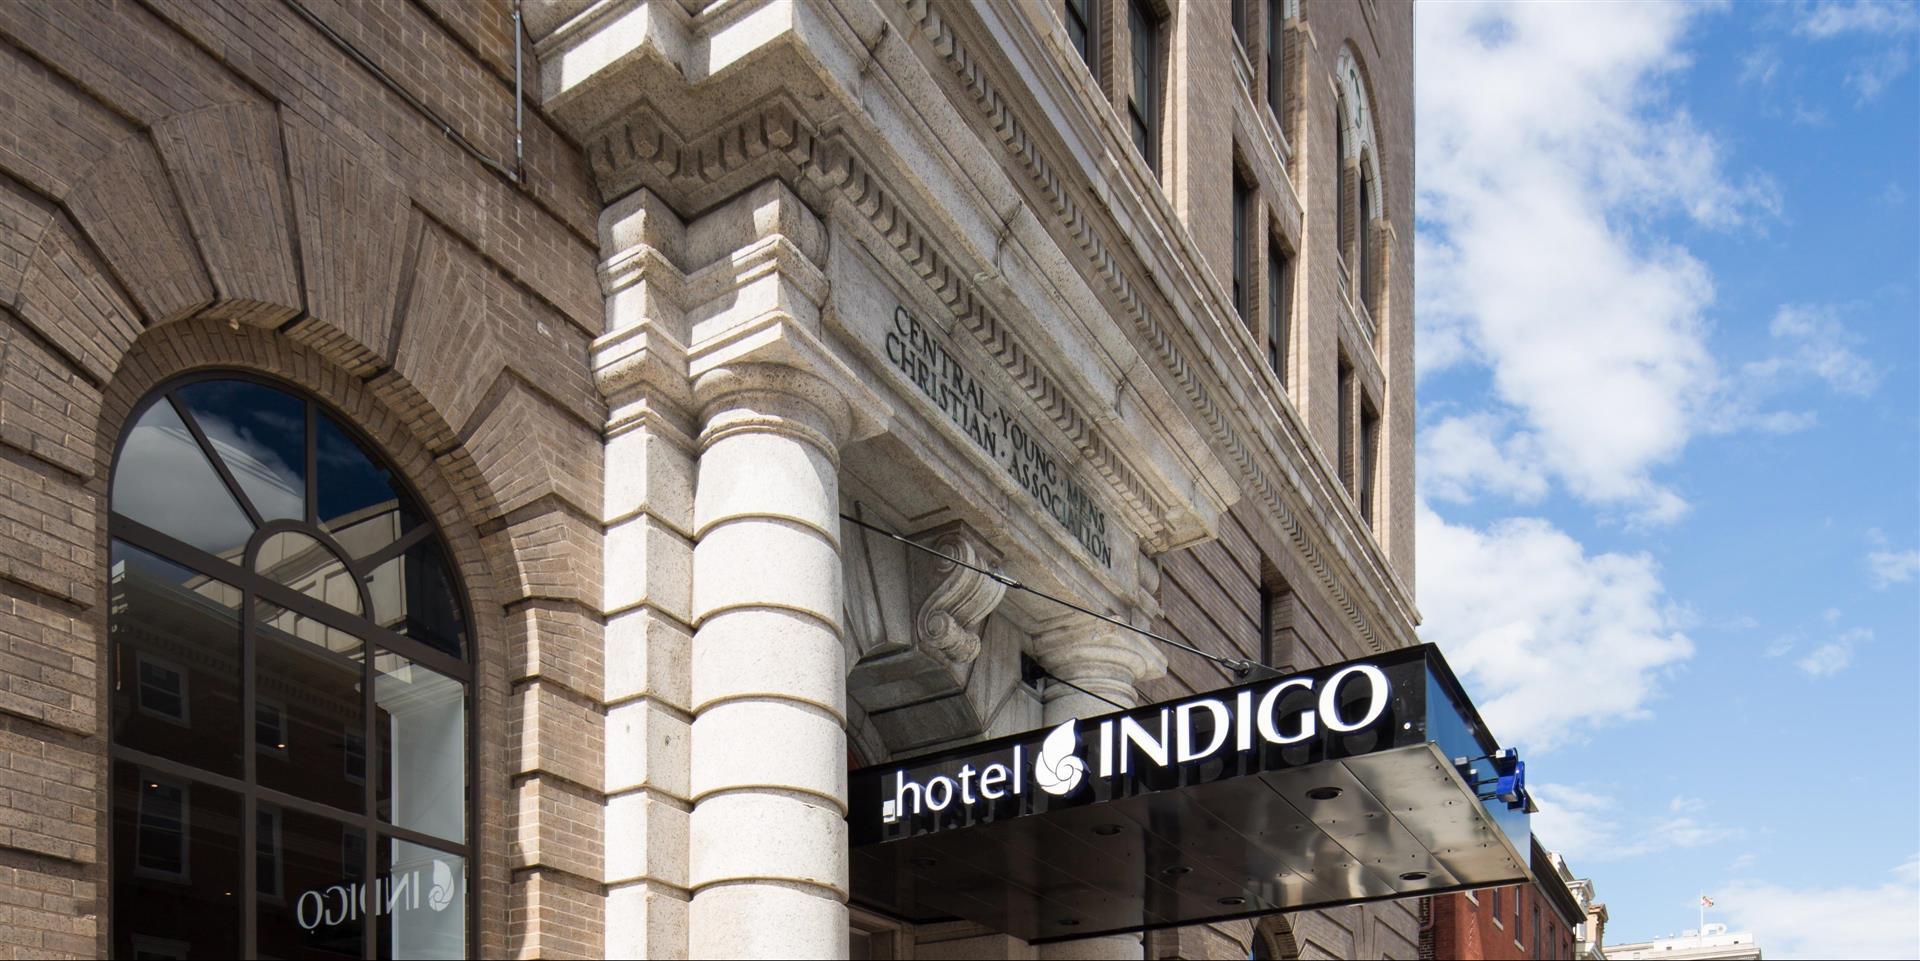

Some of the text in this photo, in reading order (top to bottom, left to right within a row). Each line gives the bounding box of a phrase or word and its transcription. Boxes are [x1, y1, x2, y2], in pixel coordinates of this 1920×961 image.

[886, 332, 1112, 568] CHRISTIAN ASSOCIATION
[895, 305, 1105, 534] CENTRAL YOUNG MENS
[897, 665, 1389, 816] hotel INDIGO
